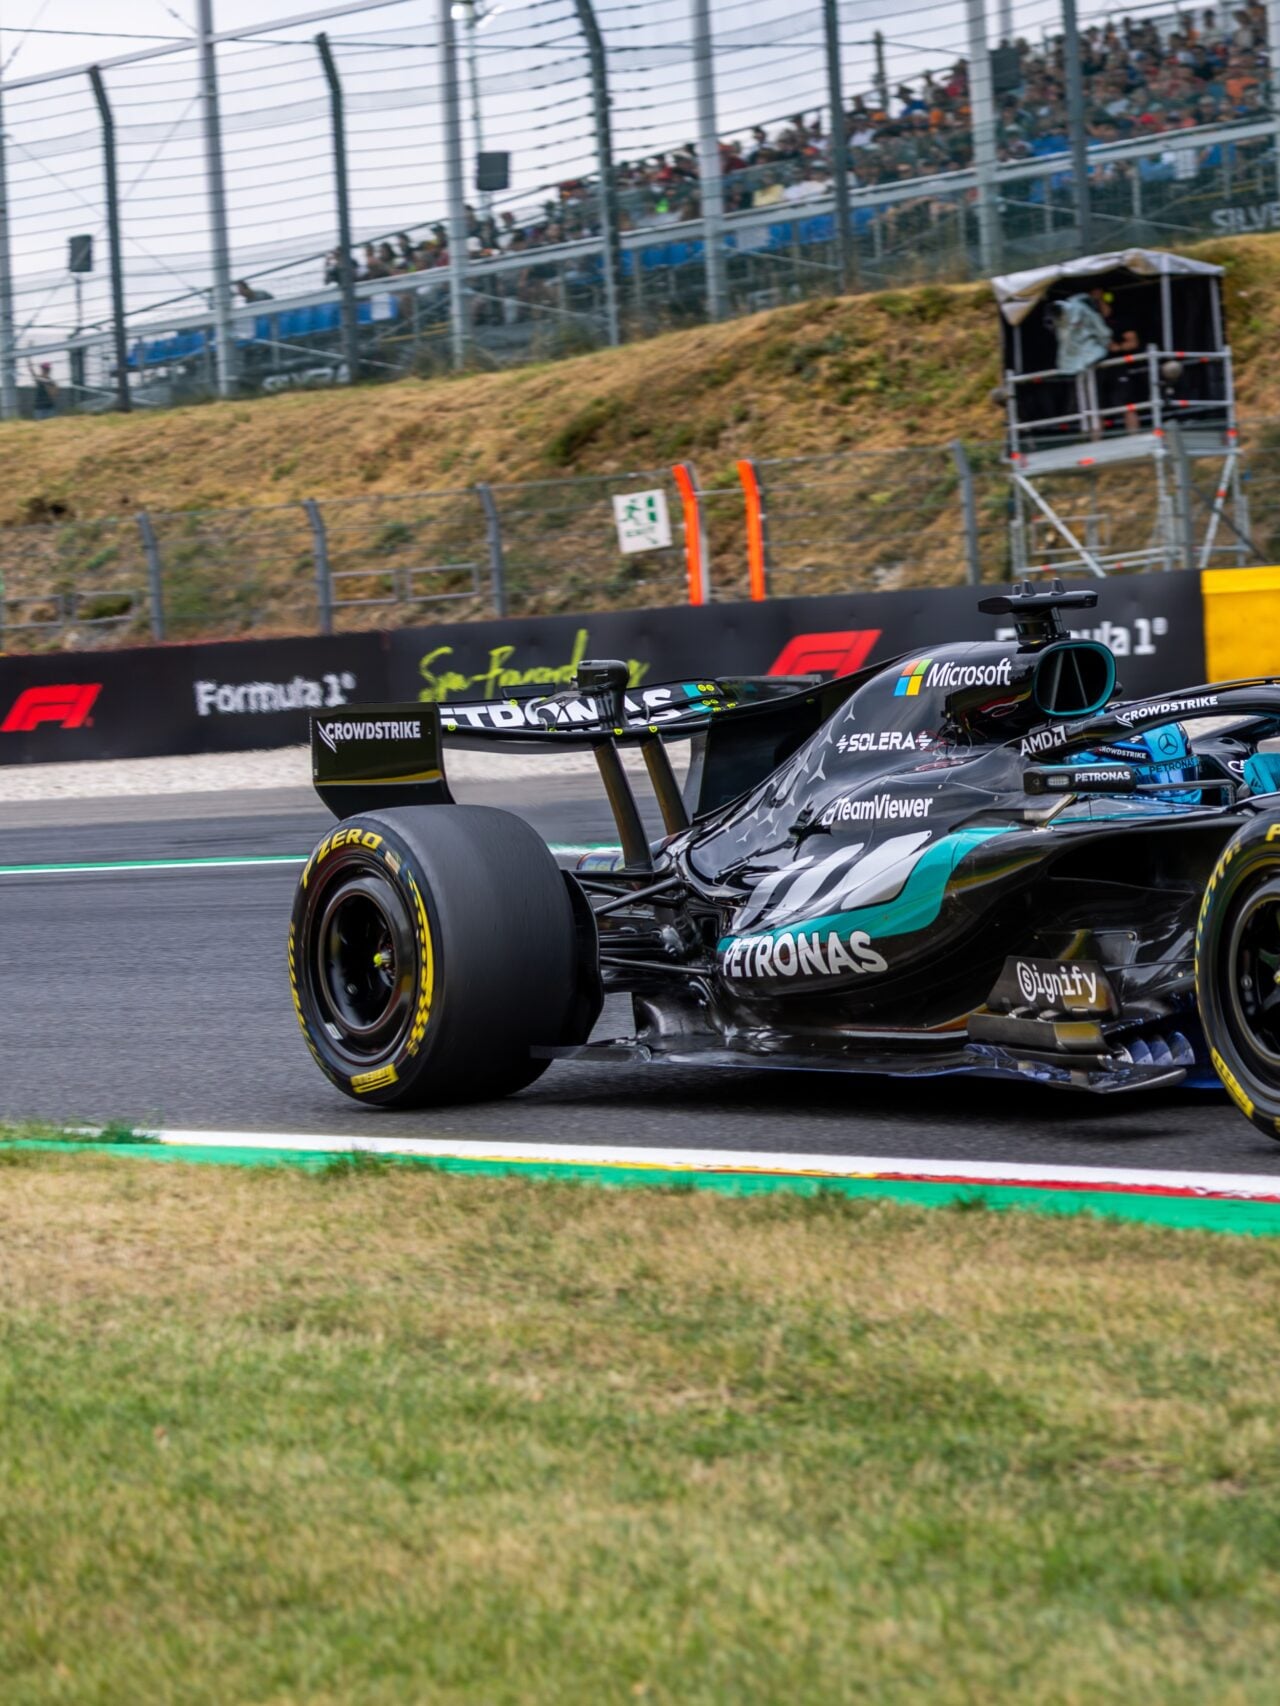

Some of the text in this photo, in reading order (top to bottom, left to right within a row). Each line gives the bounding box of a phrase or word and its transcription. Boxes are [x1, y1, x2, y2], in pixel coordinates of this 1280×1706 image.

[926, 658, 1012, 687] Microsoft
[194, 677, 323, 716] Formula
[1122, 696, 1218, 722] CROWDSTRIKE
[325, 720, 422, 740] CROWDSTRIKE
[847, 731, 916, 752] SOLERA
[1075, 771, 1131, 782] PETRONAS
[837, 794, 933, 821] TeamViewer
[317, 828, 383, 863] ZERO
[723, 930, 888, 978] PETRONAS
